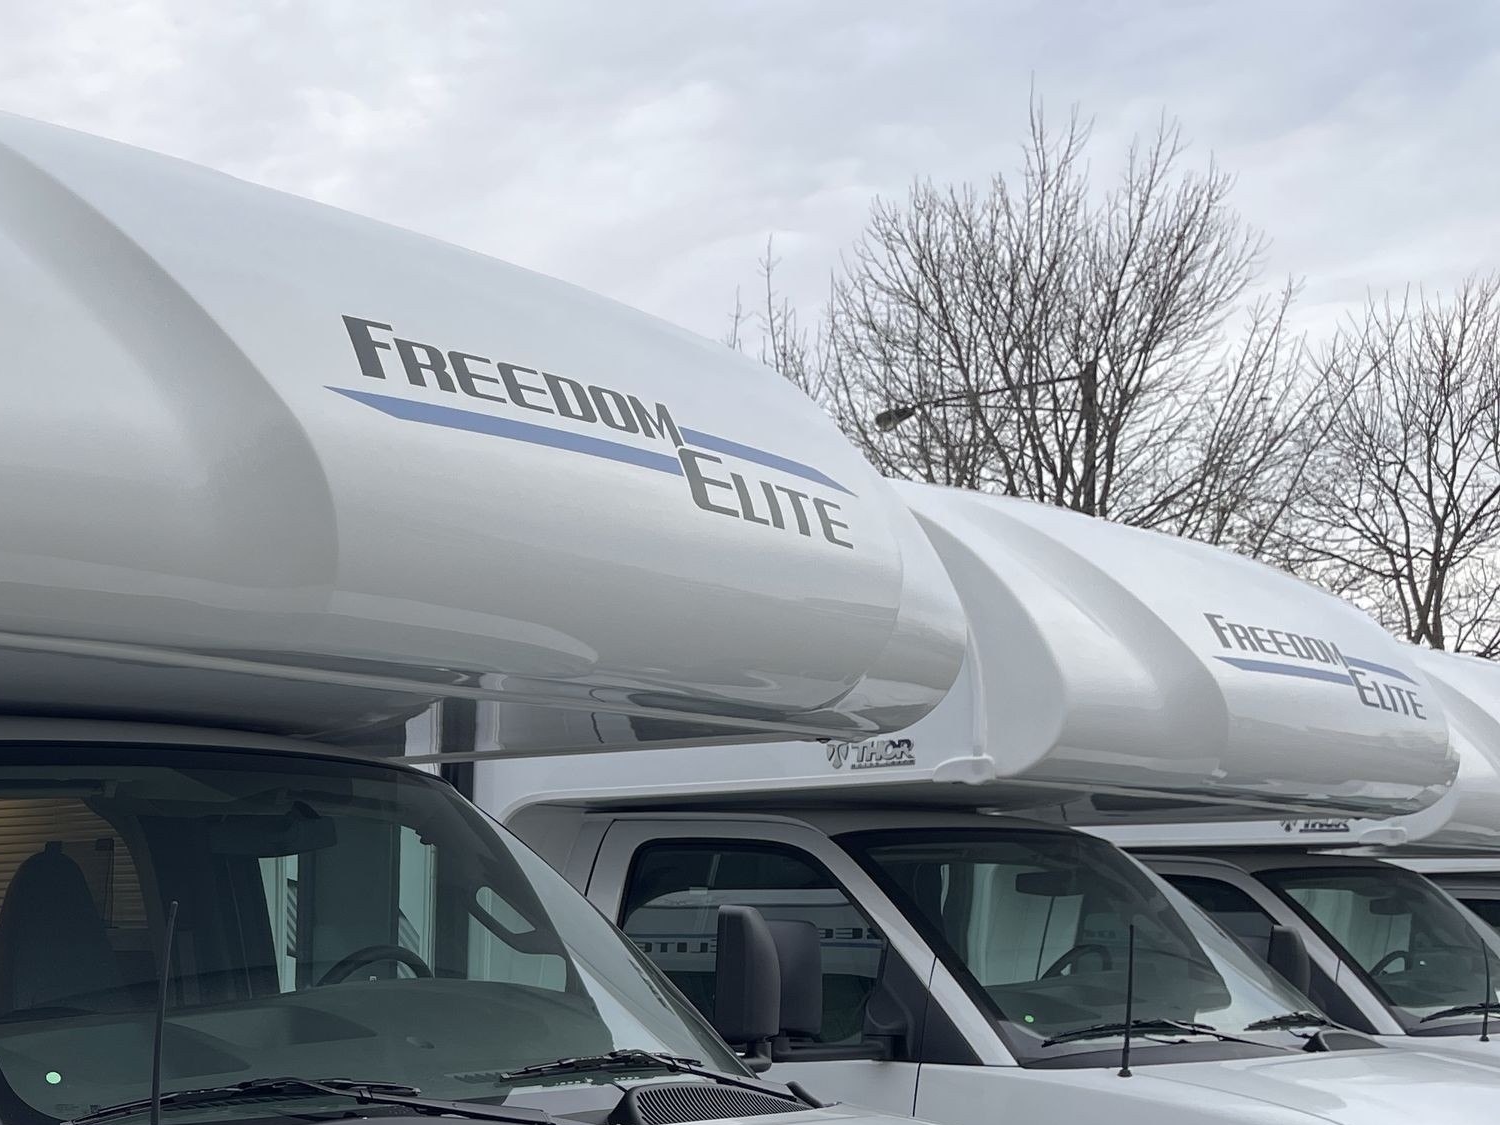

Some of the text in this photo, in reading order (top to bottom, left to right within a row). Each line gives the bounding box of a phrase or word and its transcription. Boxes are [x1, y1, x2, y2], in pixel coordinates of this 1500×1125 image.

[341, 314, 685, 448] FREEDOM
[677, 446, 855, 550] ELITE
[1203, 612, 1350, 669] FREEDOM
[1348, 668, 1428, 721] ELITE
[850, 738, 916, 763] THOR
